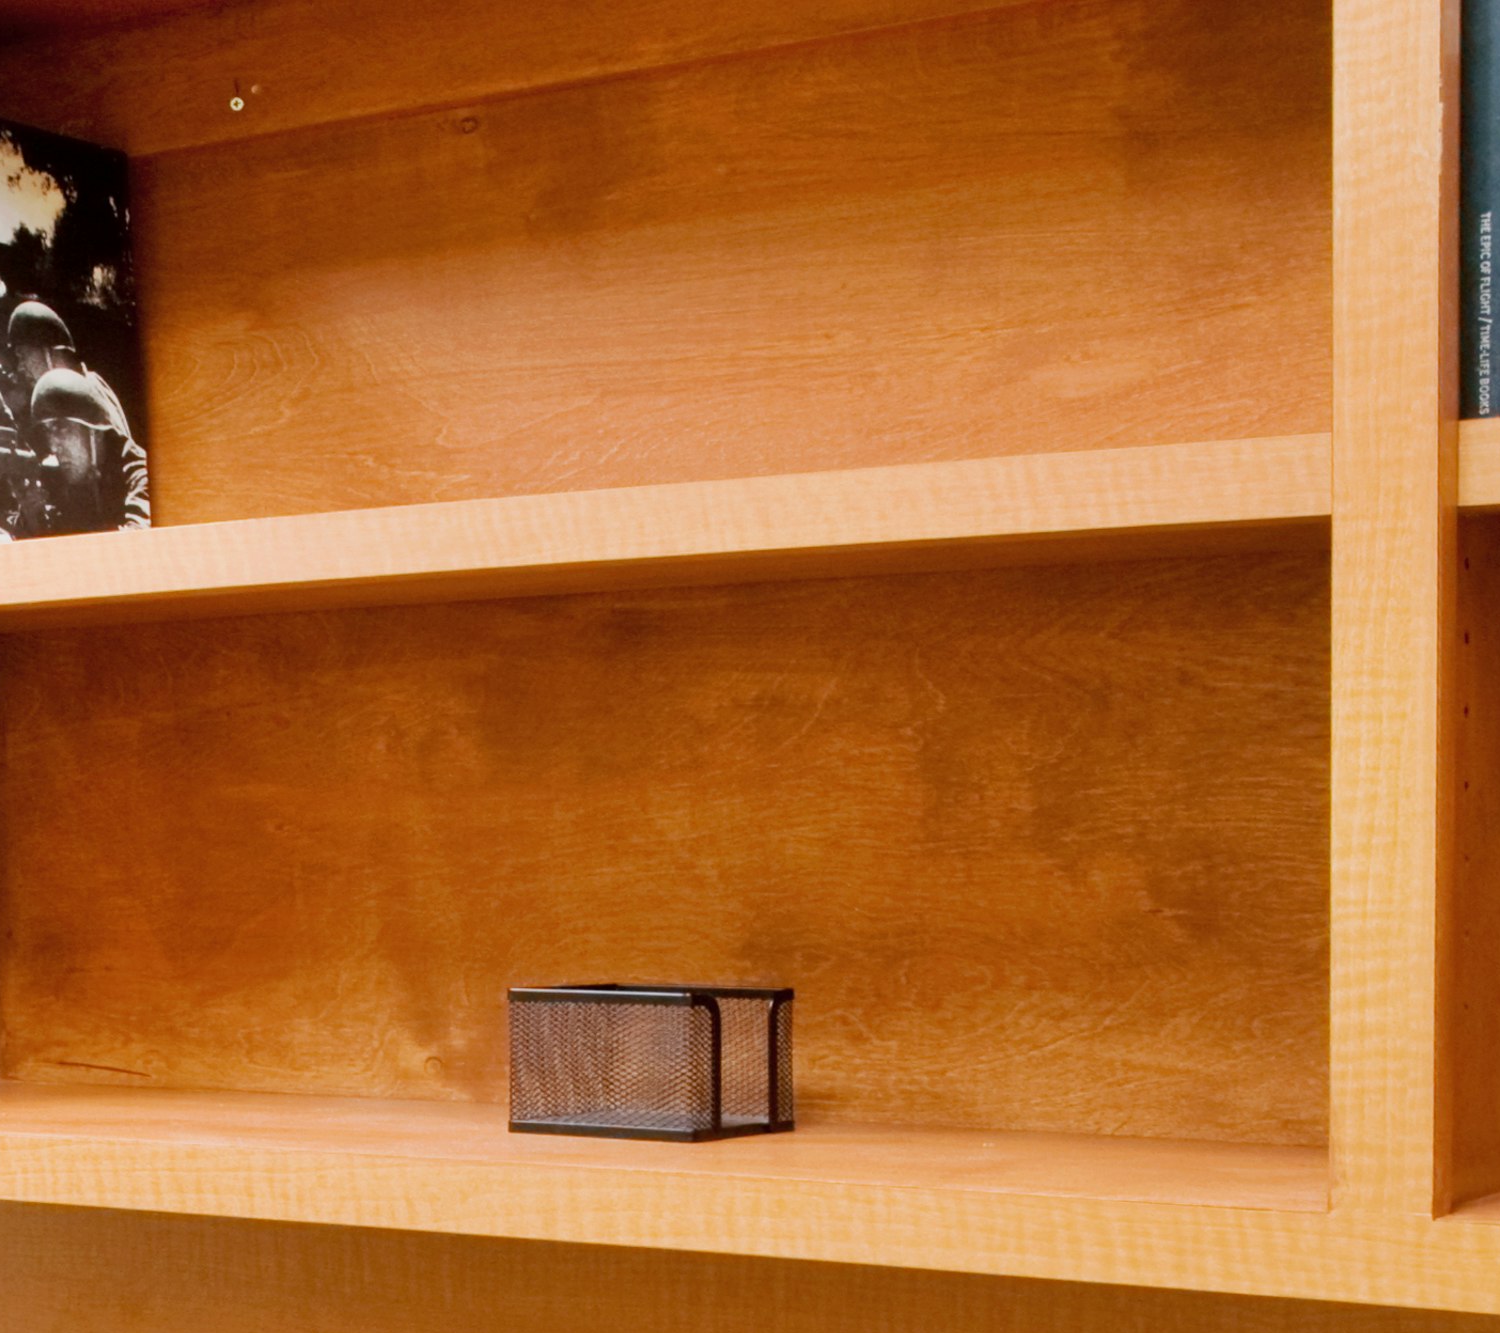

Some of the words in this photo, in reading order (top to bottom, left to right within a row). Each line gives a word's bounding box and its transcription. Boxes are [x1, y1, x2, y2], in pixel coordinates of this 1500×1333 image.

[1479, 212, 1491, 233] THE
[1479, 235, 1491, 259] EPIC
[1479, 276, 1491, 315] FLIGHT
[1478, 324, 1490, 375] TIME-LIFE
[1478, 378, 1490, 415] BOOKS
